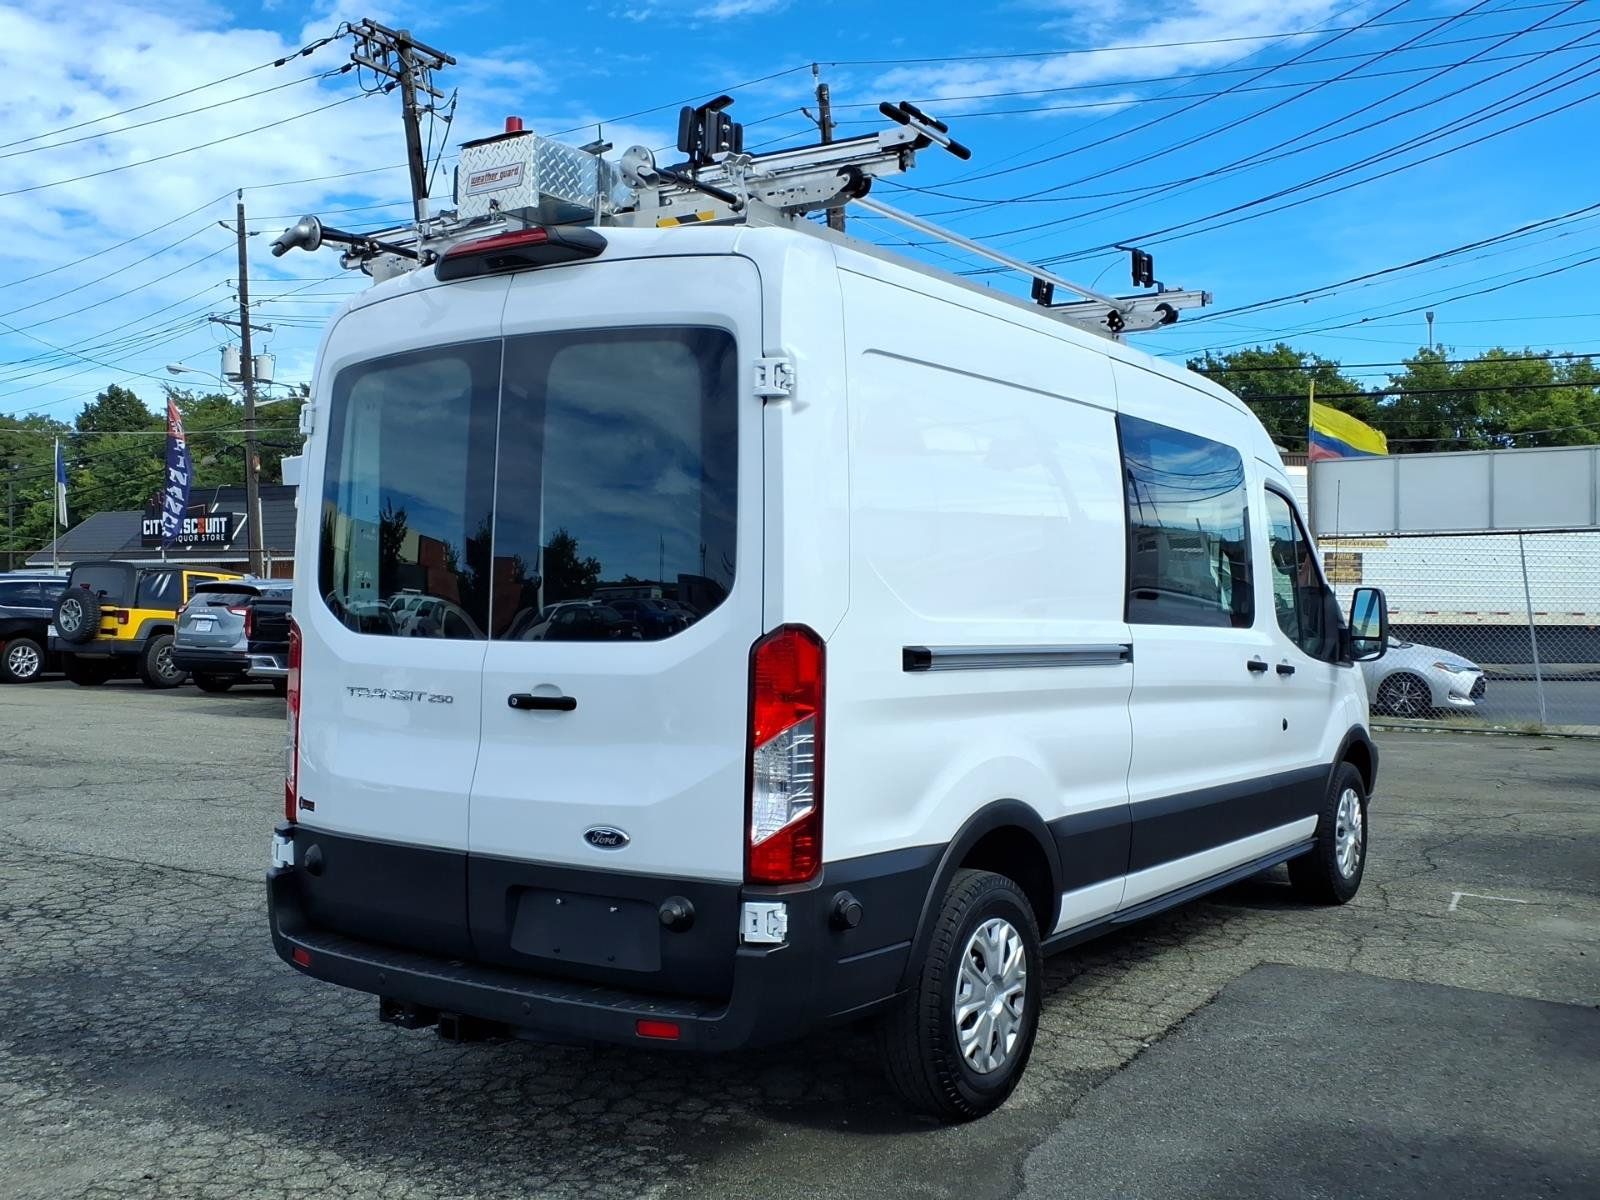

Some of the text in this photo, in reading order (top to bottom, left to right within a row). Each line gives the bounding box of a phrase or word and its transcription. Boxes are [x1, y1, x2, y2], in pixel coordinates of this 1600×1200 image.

[201, 533, 225, 542] STORE
[346, 686, 455, 704] TRANSIT 250
[591, 830, 618, 845] Ford
